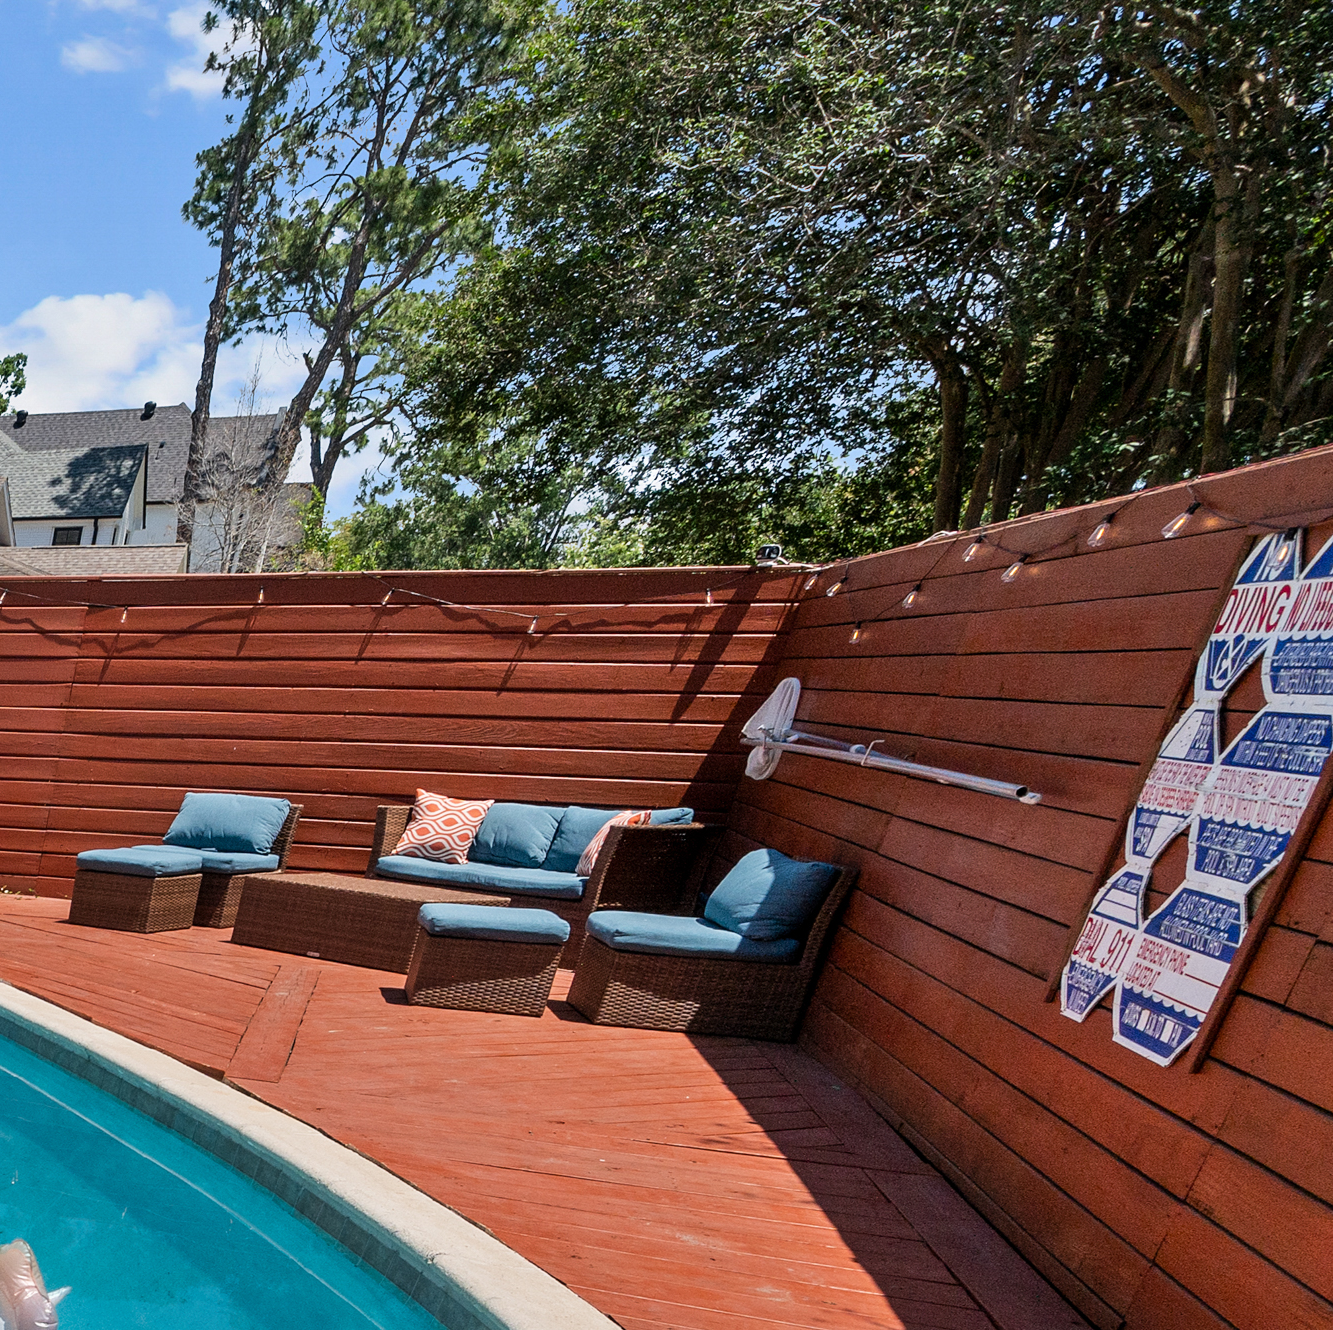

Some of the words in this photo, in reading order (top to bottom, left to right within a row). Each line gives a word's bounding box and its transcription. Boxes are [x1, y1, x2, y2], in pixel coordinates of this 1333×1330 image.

[1213, 584, 1292, 634] DIVING
[1282, 582, 1312, 632] NO
[1072, 917, 1109, 963] DIAL
[1099, 929, 1136, 973] 911
